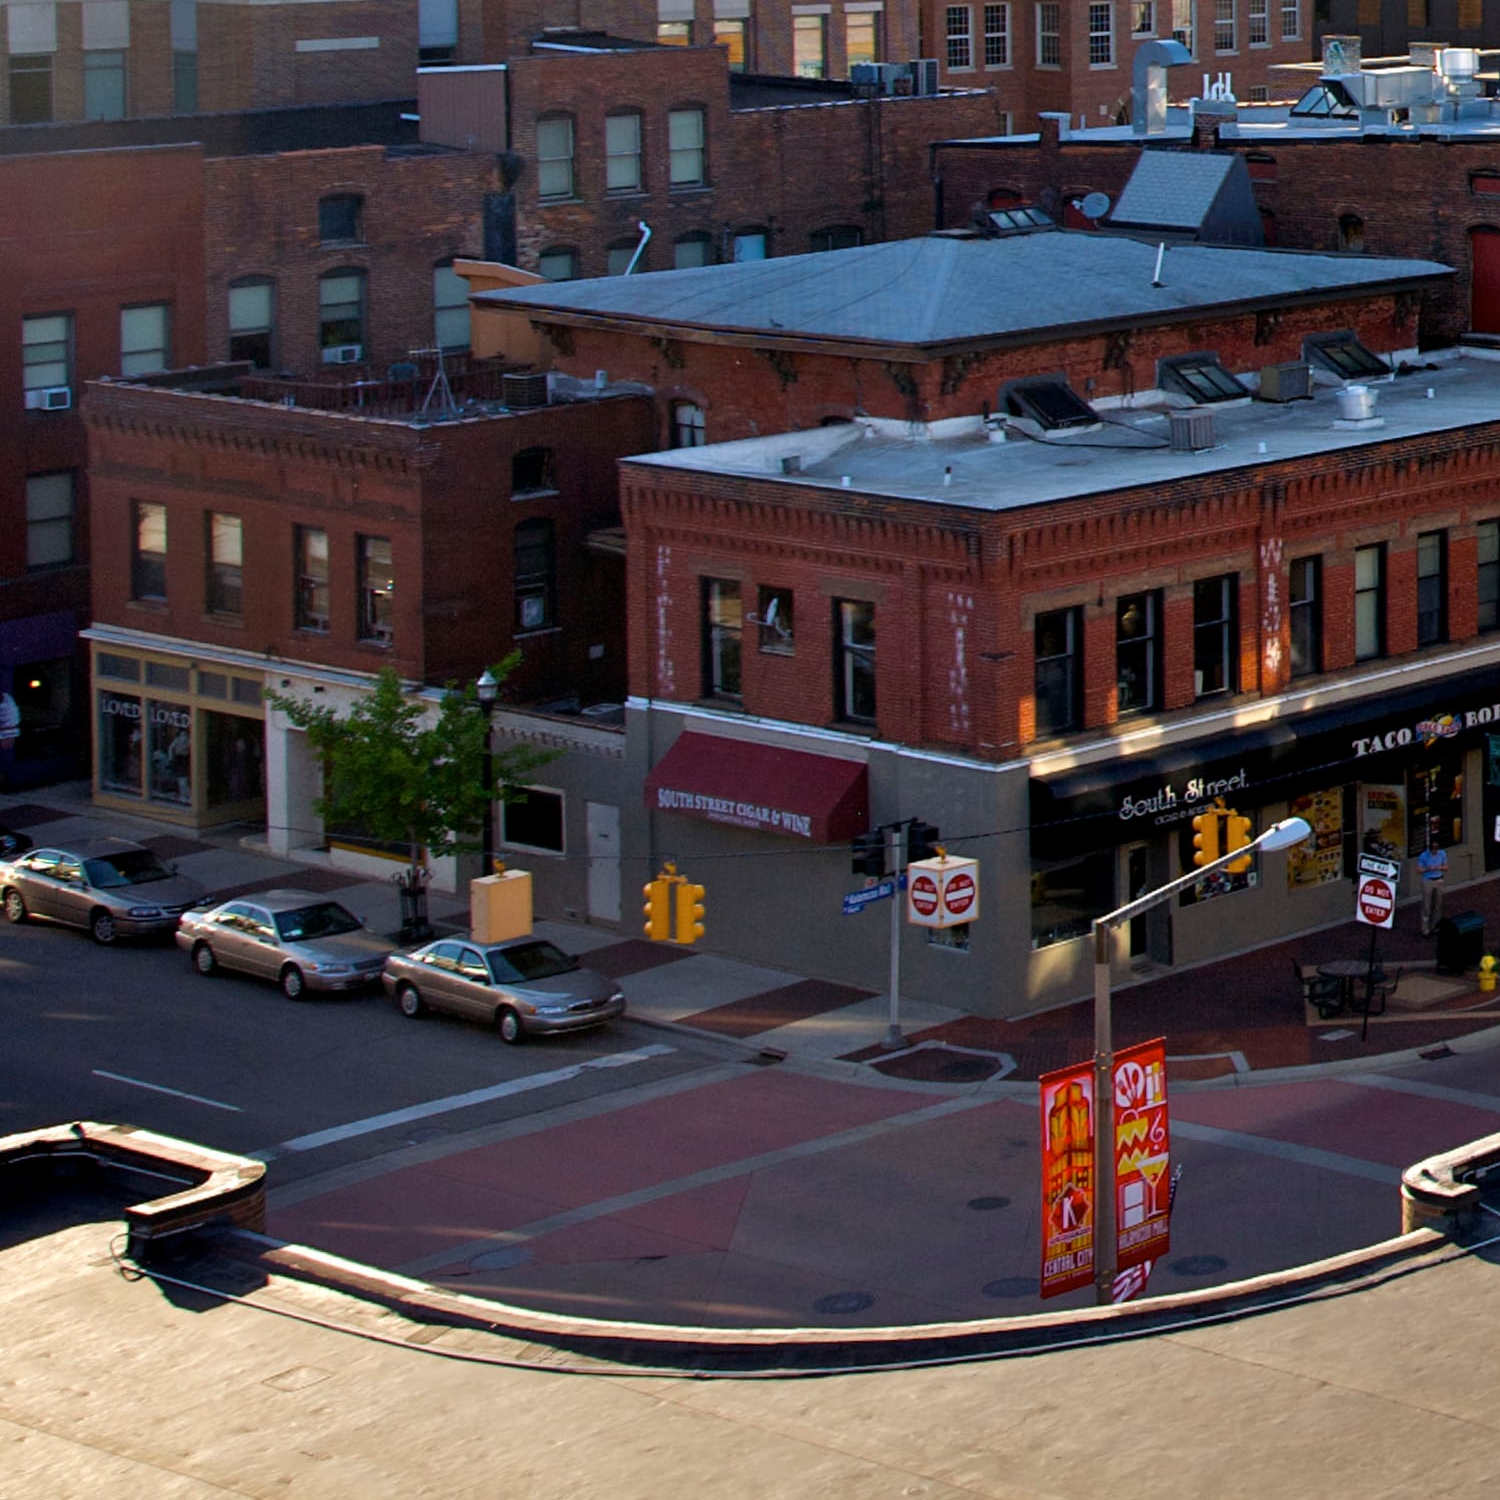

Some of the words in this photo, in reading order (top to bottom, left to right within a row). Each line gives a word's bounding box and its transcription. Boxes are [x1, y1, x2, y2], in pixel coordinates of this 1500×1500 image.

[1352, 728, 1412, 758] TACO
[1119, 784, 1177, 820] South
[1184, 767, 1249, 803] Street
[658, 788, 693, 808] SOUTH
[695, 795, 735, 814] STREET
[736, 803, 769, 823] CIGAR
[771, 809, 781, 826] &
[782, 812, 811, 838] WINE
[1364, 885, 1375, 895] DO
[1377, 888, 1390, 898] NOT
[1365, 905, 1386, 917] ENTER
[1044, 1253, 1076, 1278] CENTRAL
[1077, 1247, 1094, 1268] CITY
